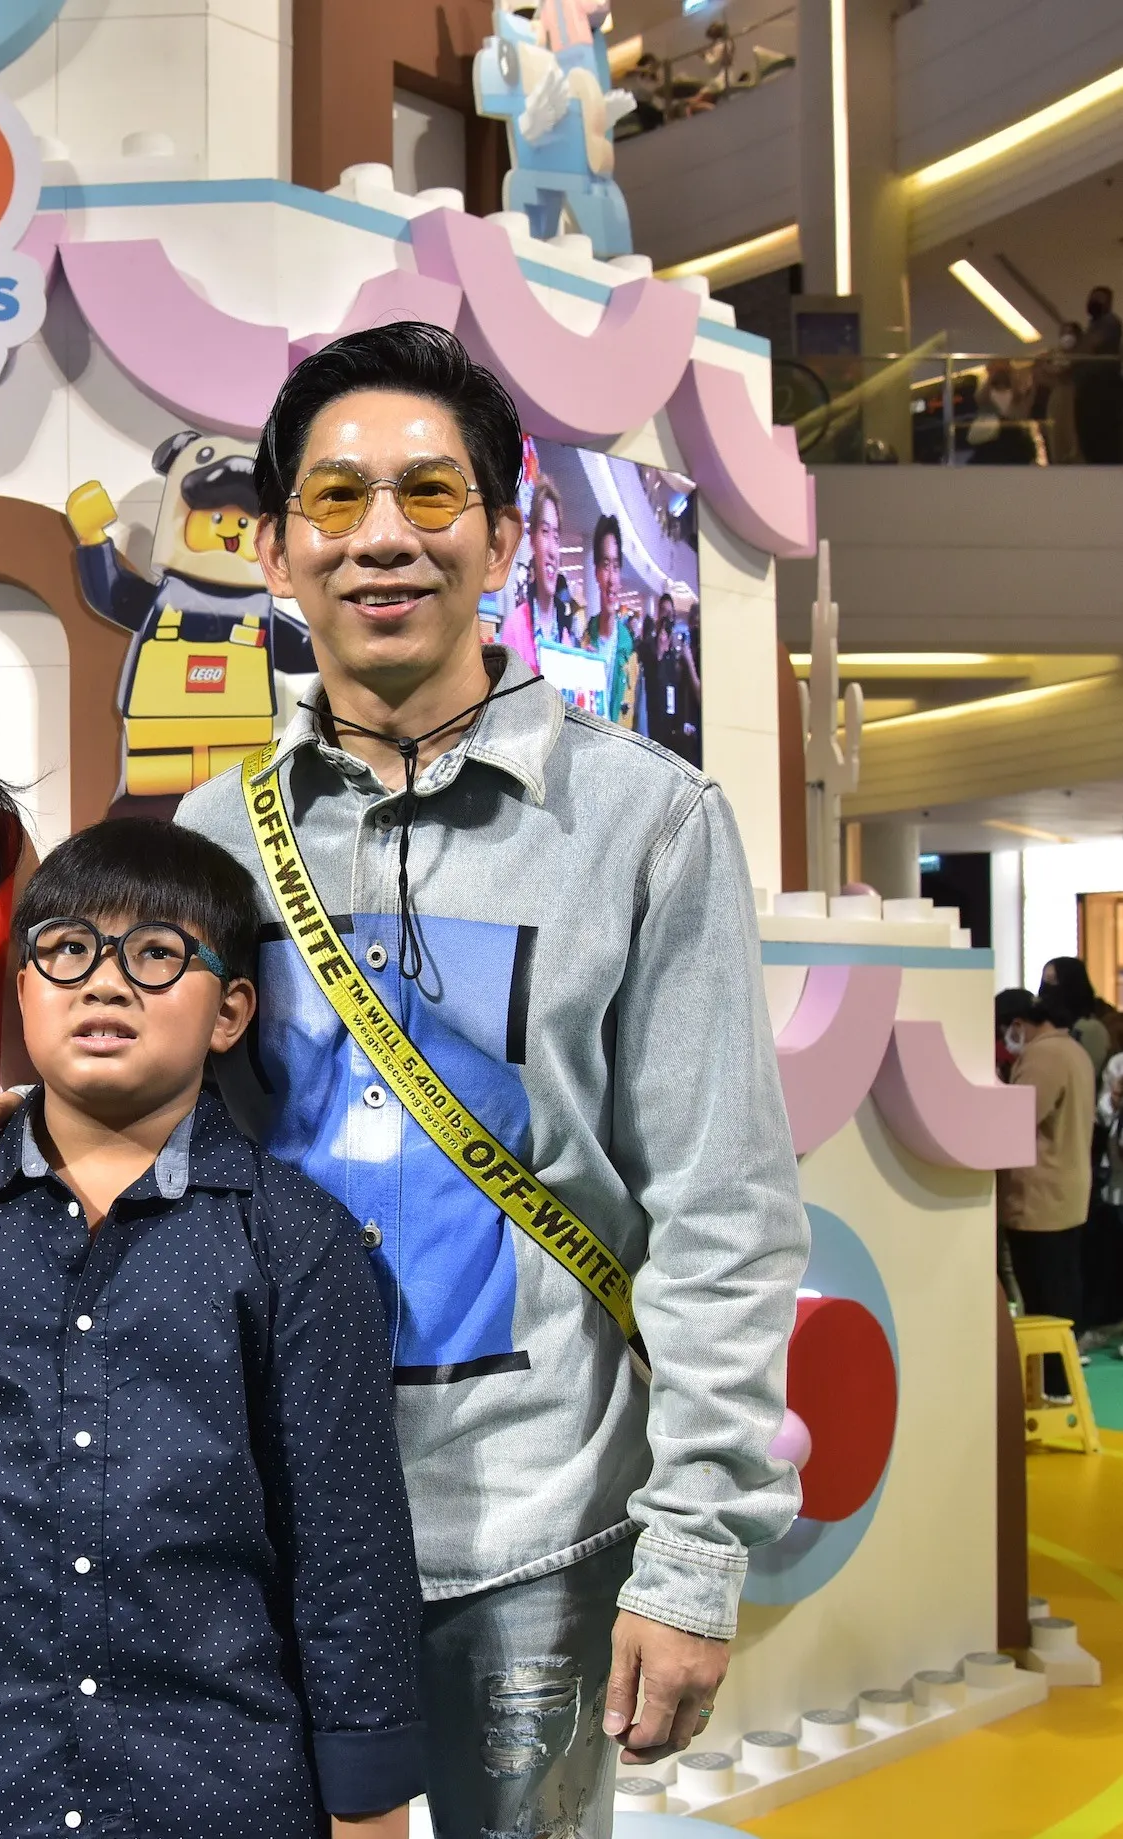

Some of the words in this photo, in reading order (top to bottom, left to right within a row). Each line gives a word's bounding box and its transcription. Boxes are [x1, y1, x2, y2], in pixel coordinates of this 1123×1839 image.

[188, 667, 223, 682] LEGO
[253, 789, 352, 986] OFF-WHITE
[366, 1005, 401, 1055] WILL
[403, 1056, 447, 1109] 5,400
[445, 1108, 472, 1139] lbs
[462, 1140, 621, 1297] OFF-WHITE
[352, 1014, 385, 1056] Weight
[382, 1055, 422, 1108] Securing
[421, 1107, 460, 1150] System
